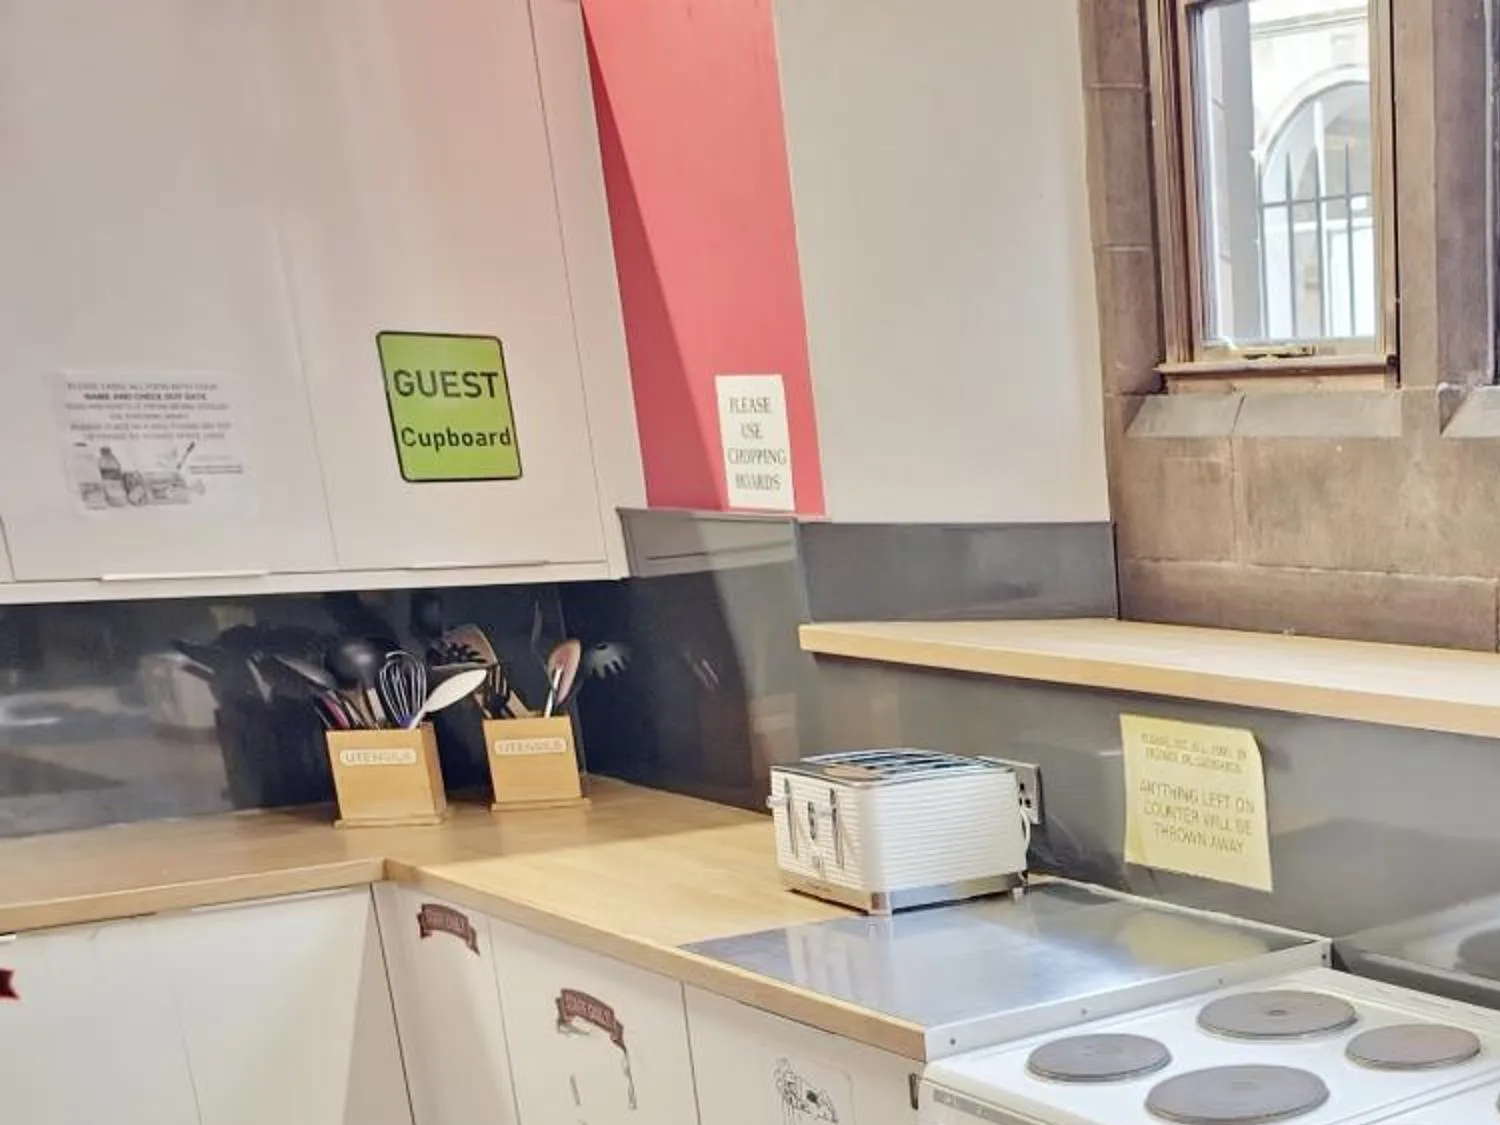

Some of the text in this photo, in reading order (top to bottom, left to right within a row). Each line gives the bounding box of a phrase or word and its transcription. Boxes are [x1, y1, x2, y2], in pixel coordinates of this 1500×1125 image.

[393, 369, 499, 398] GUEST
[729, 397, 772, 413] PLEASE
[401, 426, 511, 452] Cupboard
[741, 422, 763, 440] USE
[728, 448, 787, 465] CHOPPING
[1139, 778, 1255, 814] ANYTHING LEFT ON
[1144, 799, 1253, 836] COUNTER WILL BE
[1152, 821, 1246, 854] THROWN AWAY
